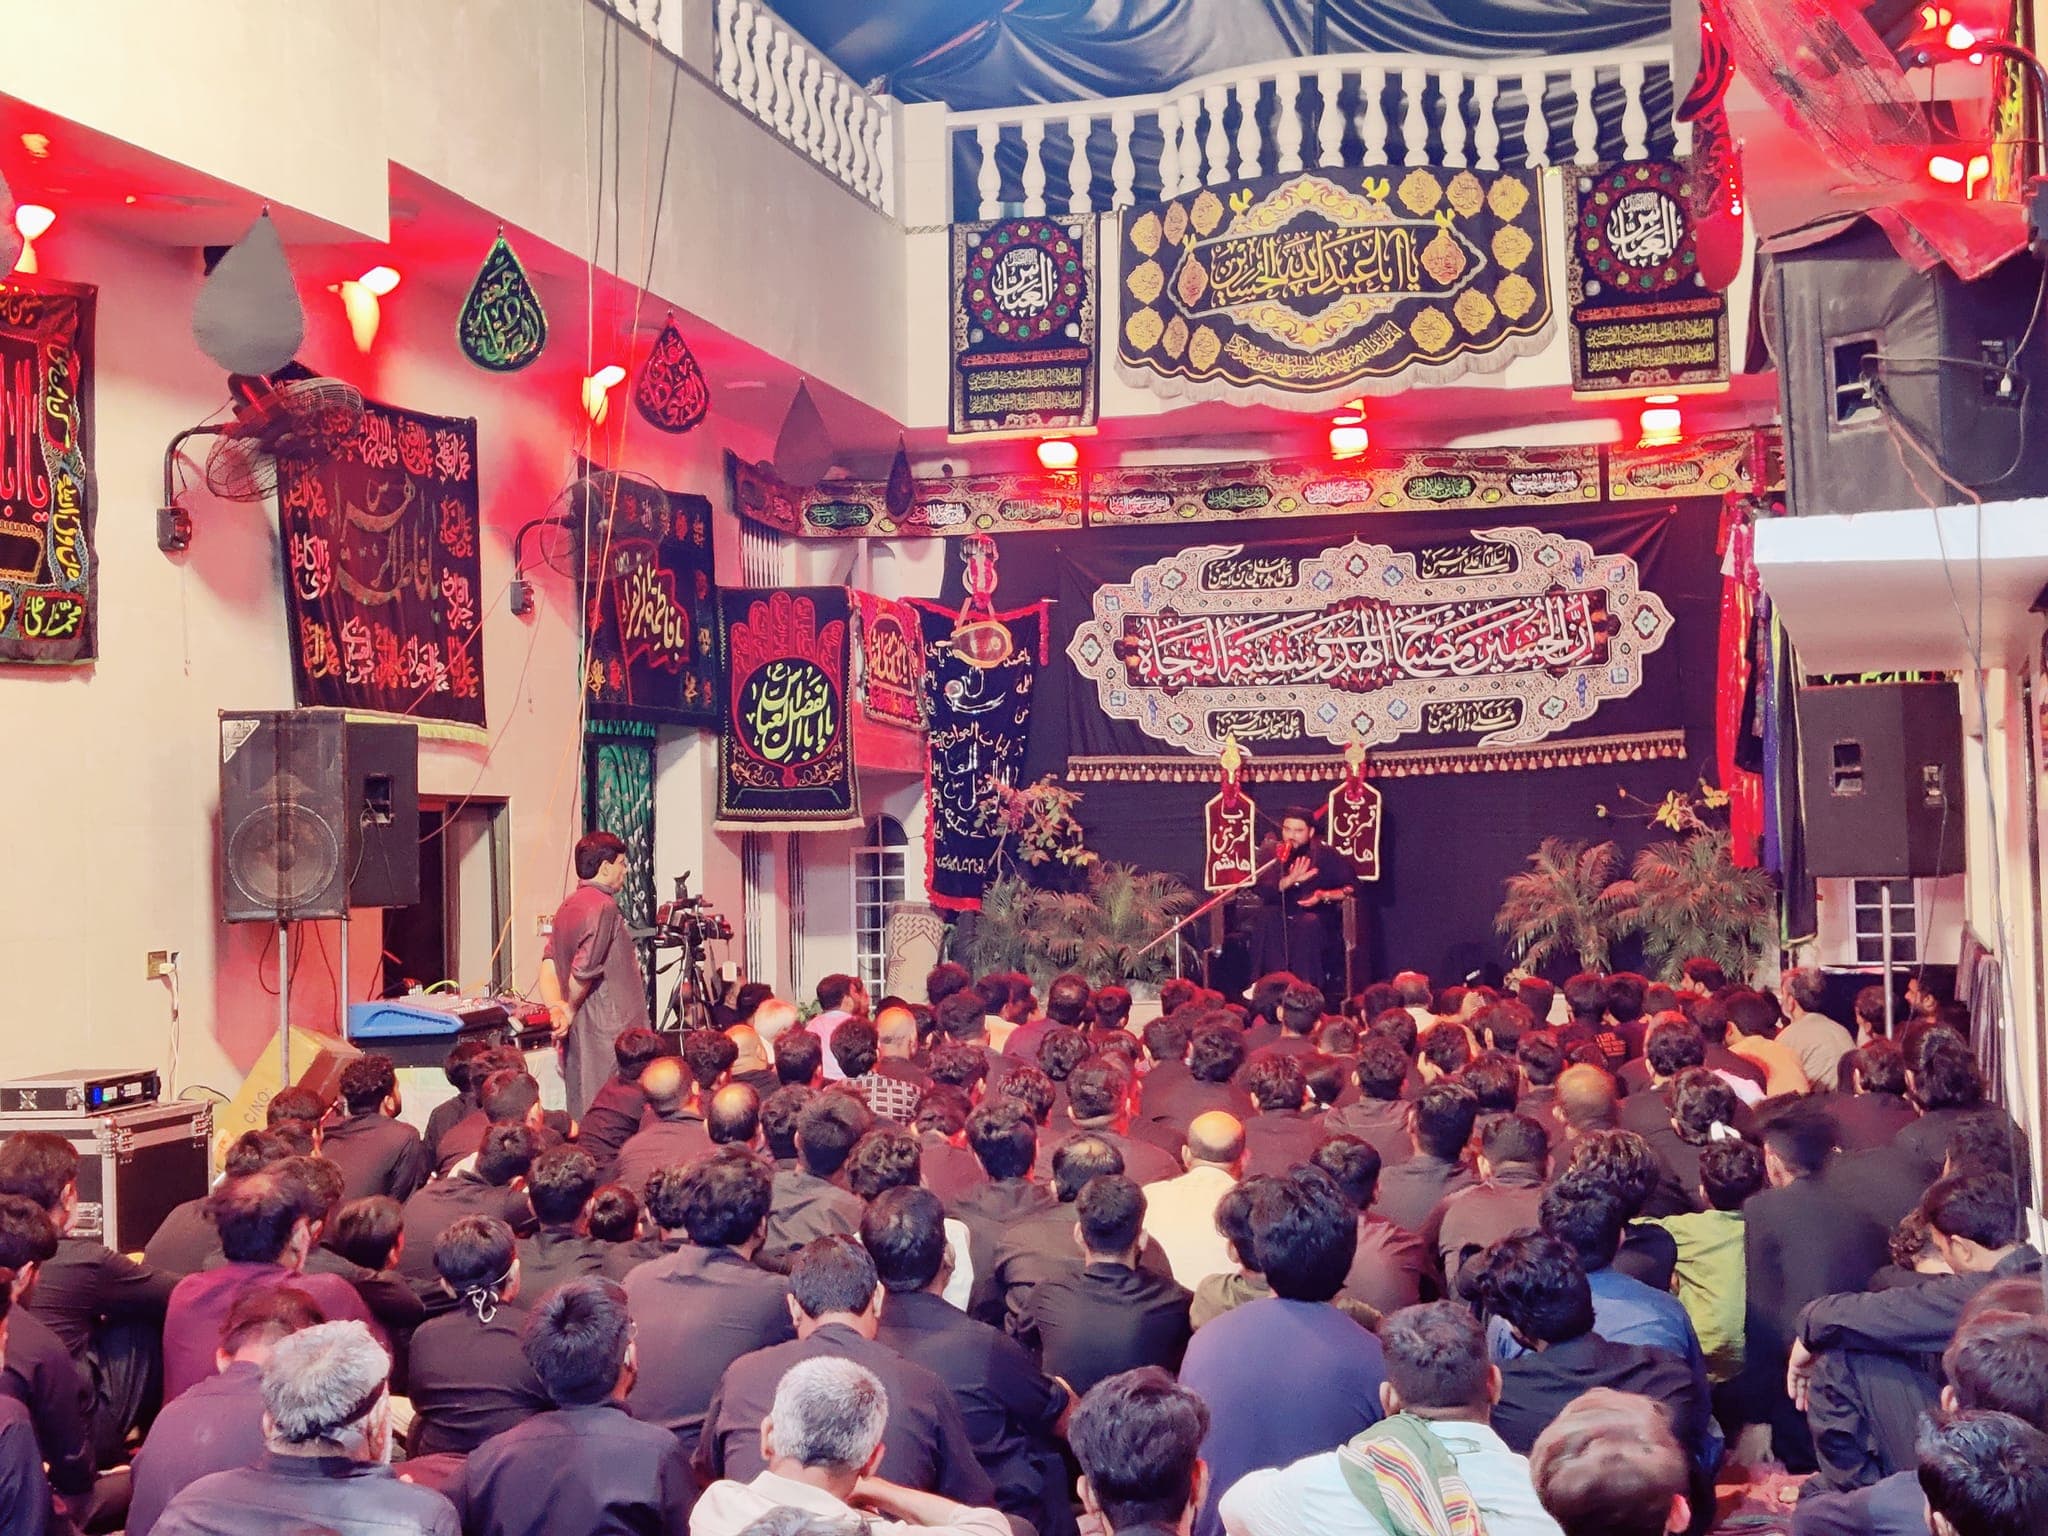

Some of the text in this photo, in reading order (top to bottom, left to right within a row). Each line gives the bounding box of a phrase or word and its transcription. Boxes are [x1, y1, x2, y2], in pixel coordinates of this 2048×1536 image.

[1607, 195, 1677, 266] العباس
[992, 252, 1053, 317] العباس
[1422, 548, 1470, 579] الحسين
[1484, 543, 1510, 569] السلام
[1138, 616, 1230, 678] النجاة
[1386, 607, 1477, 679] مصباح
[1451, 597, 1574, 676] الحسين
[1228, 819, 1251, 855] قمر
[1351, 804, 1378, 839] قمر
[1335, 837, 1375, 862] هاش
[1212, 852, 1251, 885] هاشم
